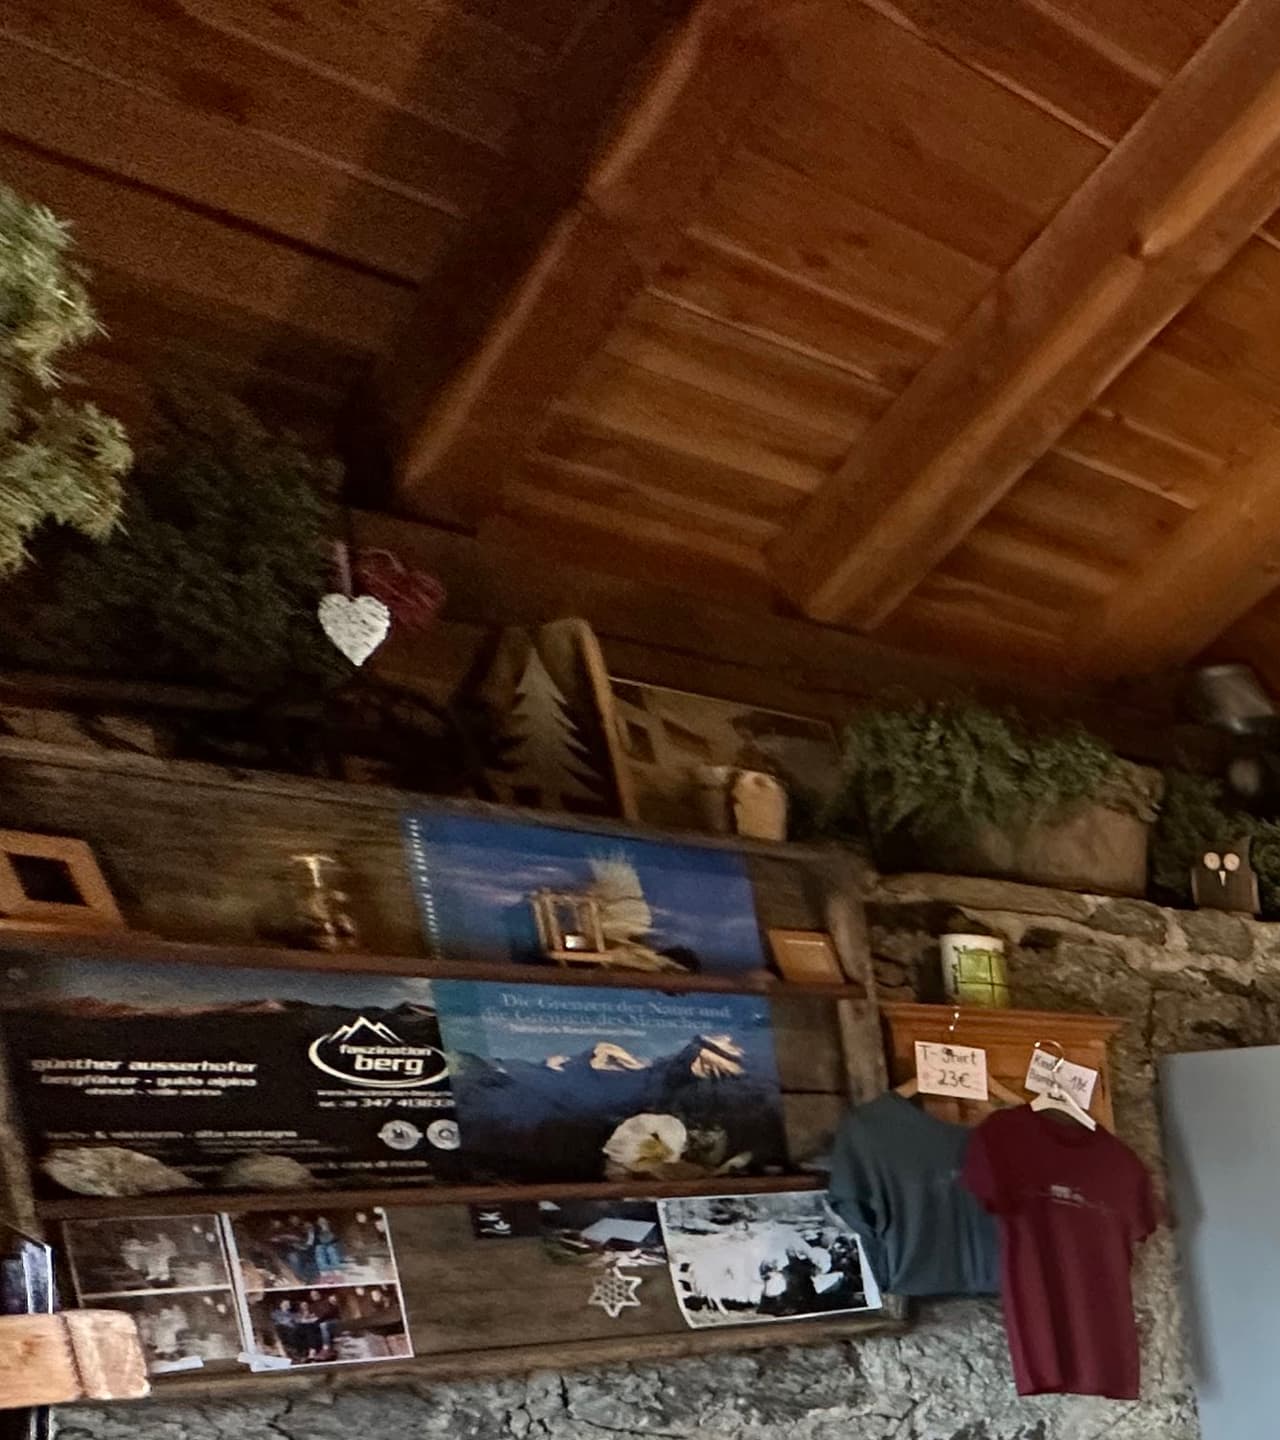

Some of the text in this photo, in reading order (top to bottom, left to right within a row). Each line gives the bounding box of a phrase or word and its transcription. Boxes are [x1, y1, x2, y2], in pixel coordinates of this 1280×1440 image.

[338, 1044, 433, 1056] faszination
[31, 1058, 258, 1073] günther ausserhofer
[353, 1054, 425, 1076] berg
[40, 1074, 140, 1087] bergführer
[936, 1071, 973, 1090] 23€
